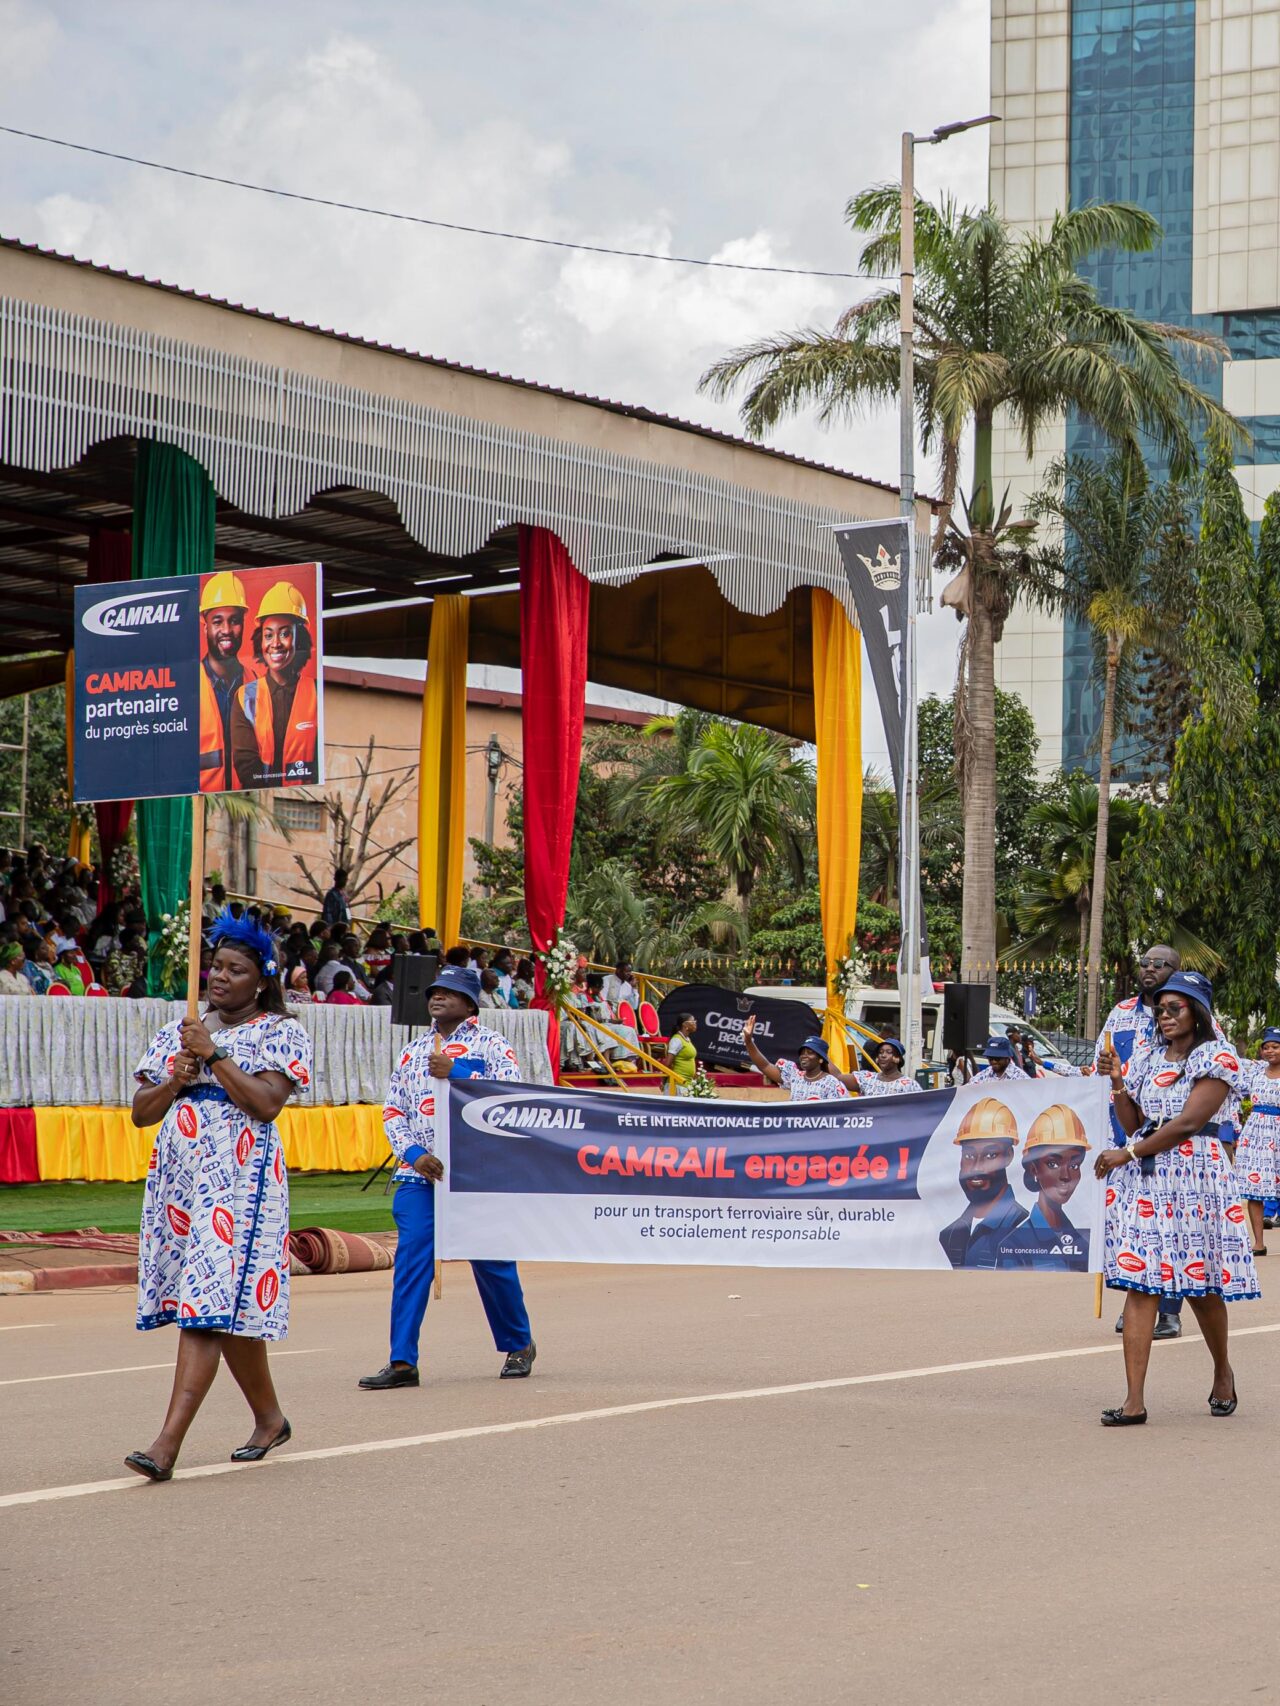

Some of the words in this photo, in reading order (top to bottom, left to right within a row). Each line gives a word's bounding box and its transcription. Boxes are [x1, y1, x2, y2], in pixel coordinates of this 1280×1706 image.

[103, 603, 180, 628] CAMRAIL
[86, 668, 176, 694] CAMRAIL
[86, 693, 179, 723] partenaire
[85, 725, 100, 739] du
[103, 720, 150, 740] progrès
[152, 717, 188, 734] social
[287, 768, 312, 777] AGL
[487, 1105, 586, 1129] CAMRAIL
[617, 1112, 648, 1127] FÊTE
[650, 1115, 760, 1128] INTERNATIONALE
[763, 1116, 782, 1128] DU
[786, 1116, 840, 1128] TRAVAIL
[843, 1116, 873, 1128] 2025
[577, 1144, 736, 1178] CAMRAIL
[744, 1143, 889, 1187] engagée
[896, 1147, 910, 1180] !
[594, 1205, 628, 1220] pour
[632, 1205, 650, 1218] un
[654, 1205, 723, 1221] transport
[727, 1205, 802, 1220] ferroviaire
[807, 1206, 834, 1222] sûr,
[838, 1208, 895, 1222] durable
[640, 1224, 655, 1237] et
[659, 1223, 747, 1239] socialement
[751, 1226, 841, 1242] responsable
[1014, 1247, 1048, 1255] concession
[1049, 1245, 1083, 1255] AGL
